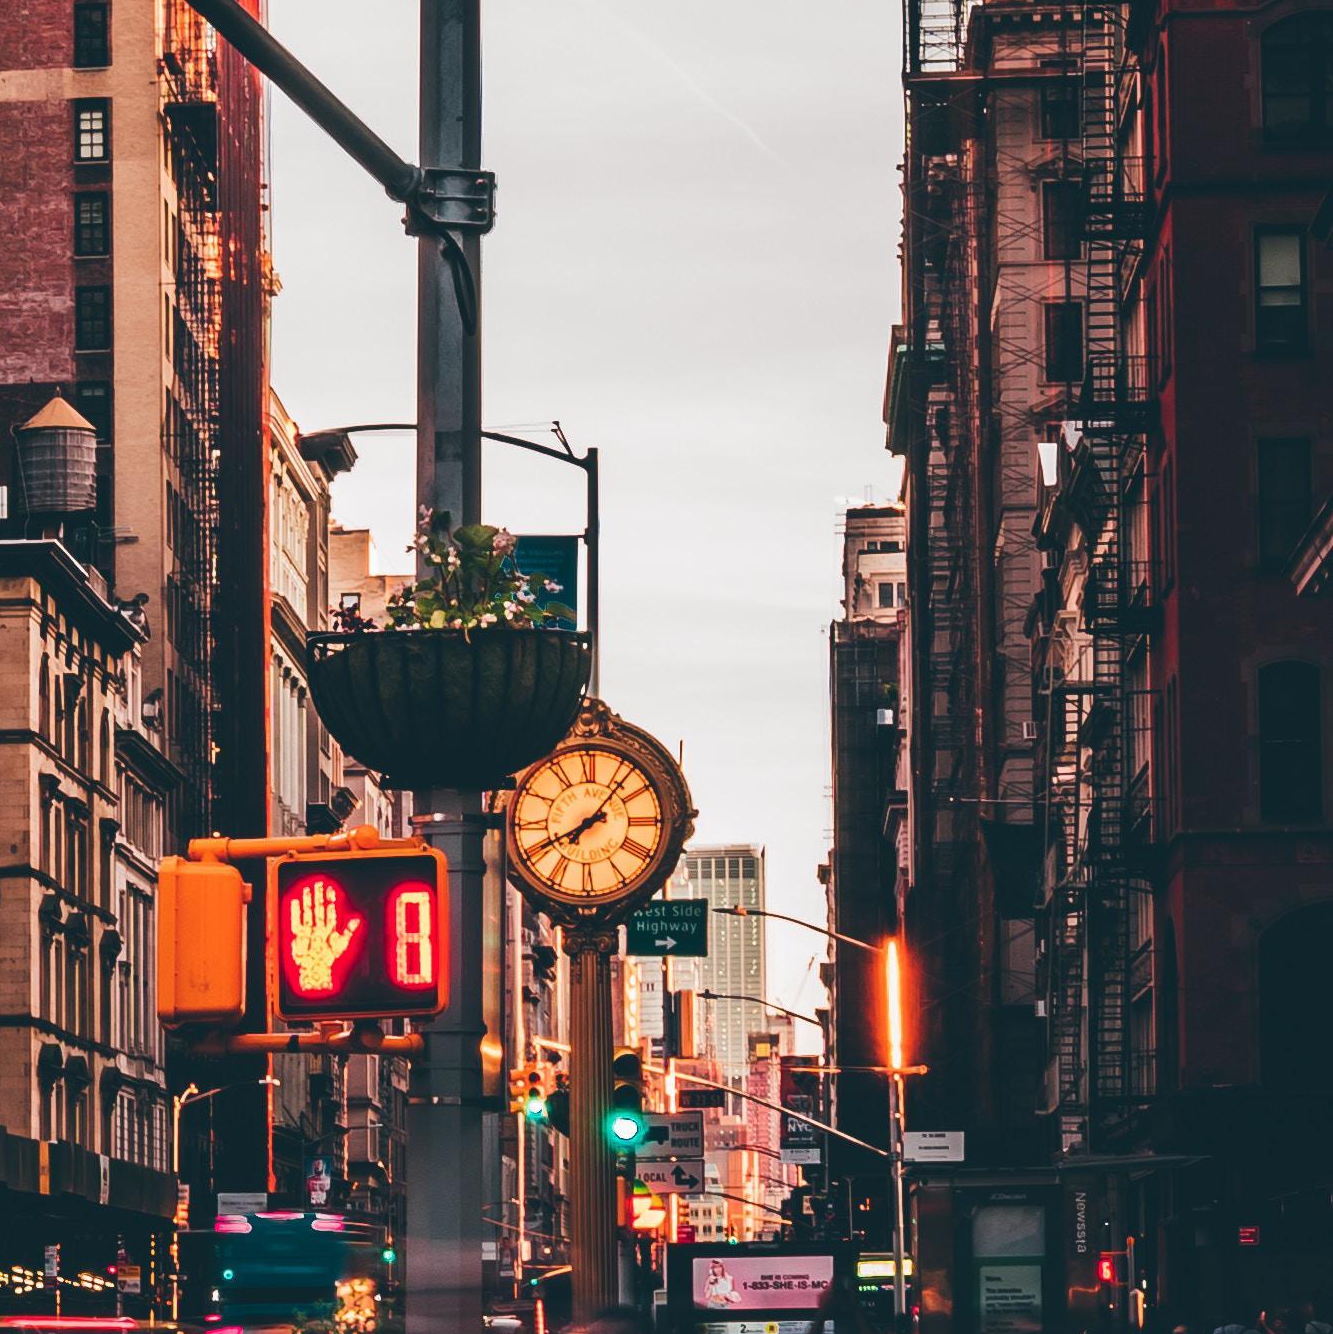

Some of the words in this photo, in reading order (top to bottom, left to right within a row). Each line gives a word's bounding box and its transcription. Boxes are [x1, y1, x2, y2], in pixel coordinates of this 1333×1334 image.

[551, 792, 578, 824] FIFTH
[672, 905, 702, 917] Side
[636, 920, 698, 935] Highway
[671, 1122, 700, 1132] TRUCK
[788, 1123, 813, 1132] NYC
[671, 1137, 700, 1148] ROUTE
[638, 1172, 668, 1183] LOCAL
